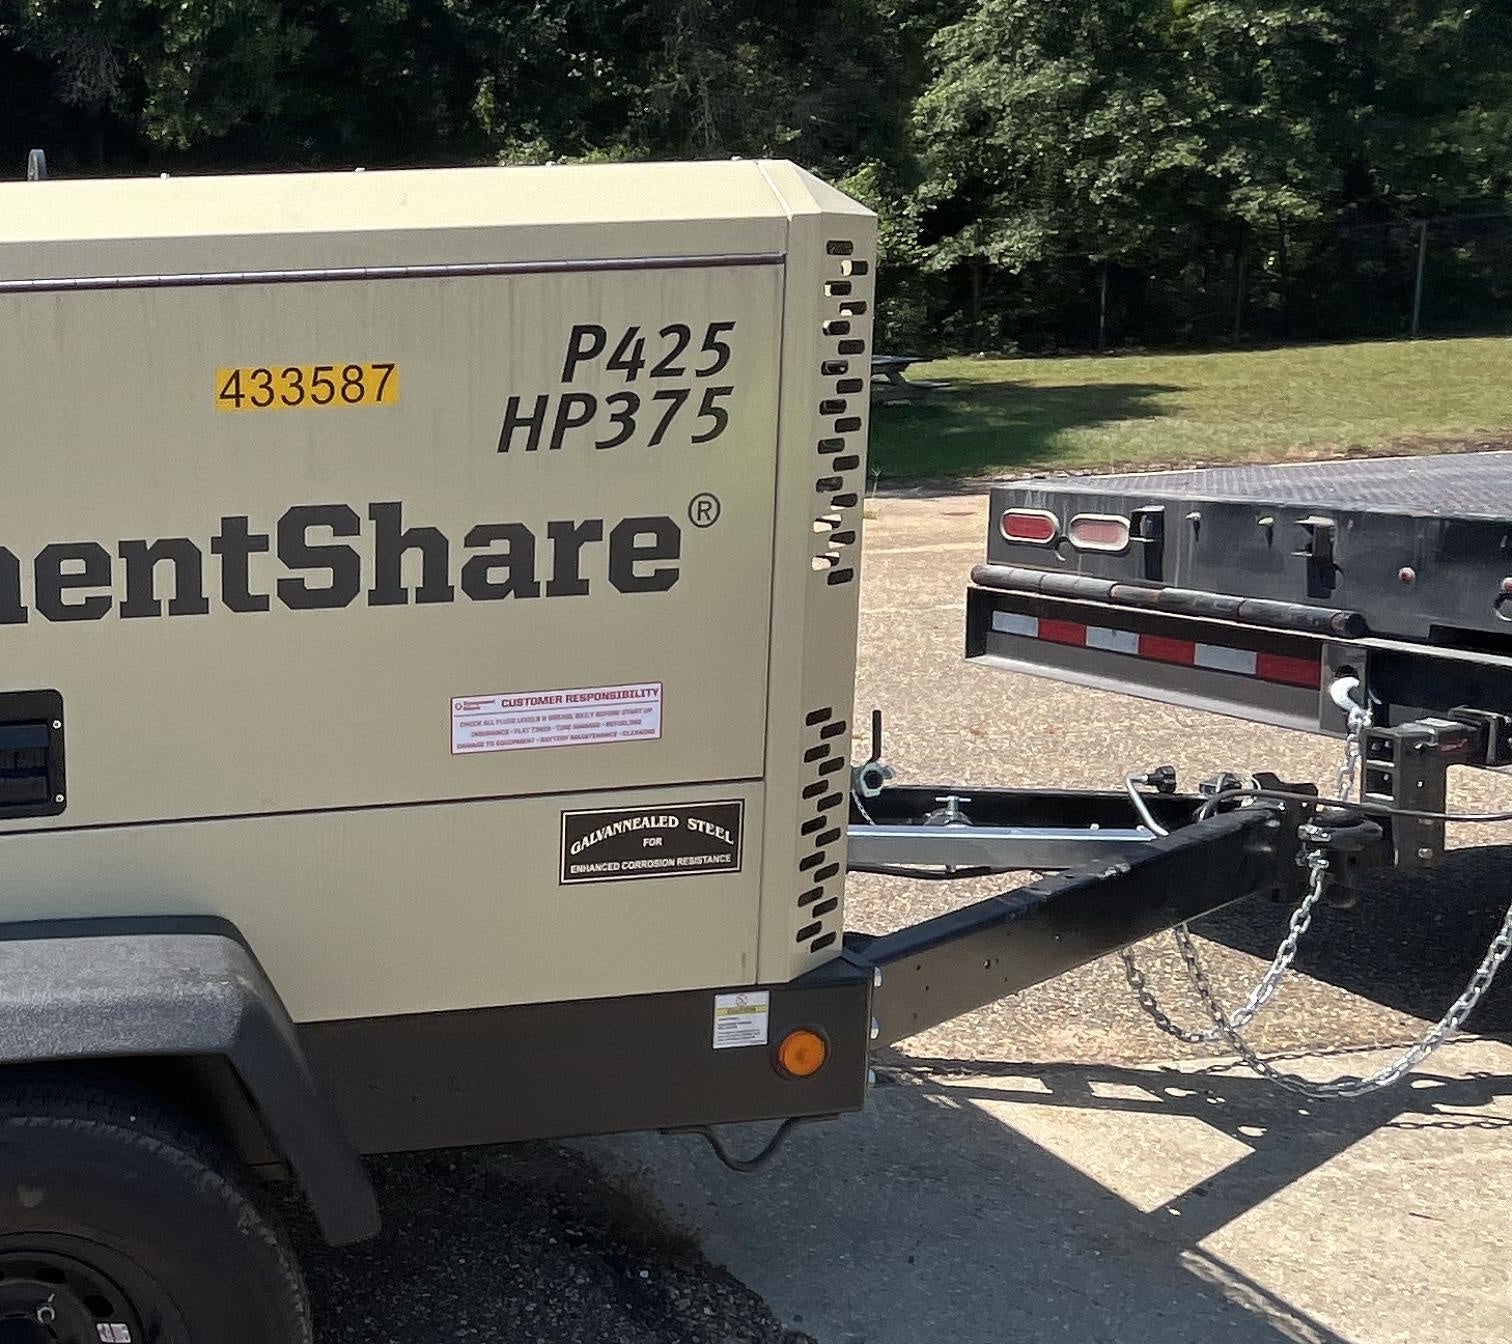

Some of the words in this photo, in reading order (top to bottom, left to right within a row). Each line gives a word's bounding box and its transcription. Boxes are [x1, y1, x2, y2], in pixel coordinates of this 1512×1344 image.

[560, 320, 737, 384] P425
[219, 362, 396, 408] 433587
[496, 385, 735, 453] HP375
[501, 695, 563, 708] CUSTOMER
[566, 688, 659, 703] RESPONSIBILITY
[570, 815, 679, 855] GALVANNEALED
[687, 817, 735, 845] STEEL
[642, 837, 663, 848] FOR
[570, 861, 621, 874] ENHANCED
[621, 858, 675, 871] CORROSION
[676, 853, 732, 867] RESISTANCE
